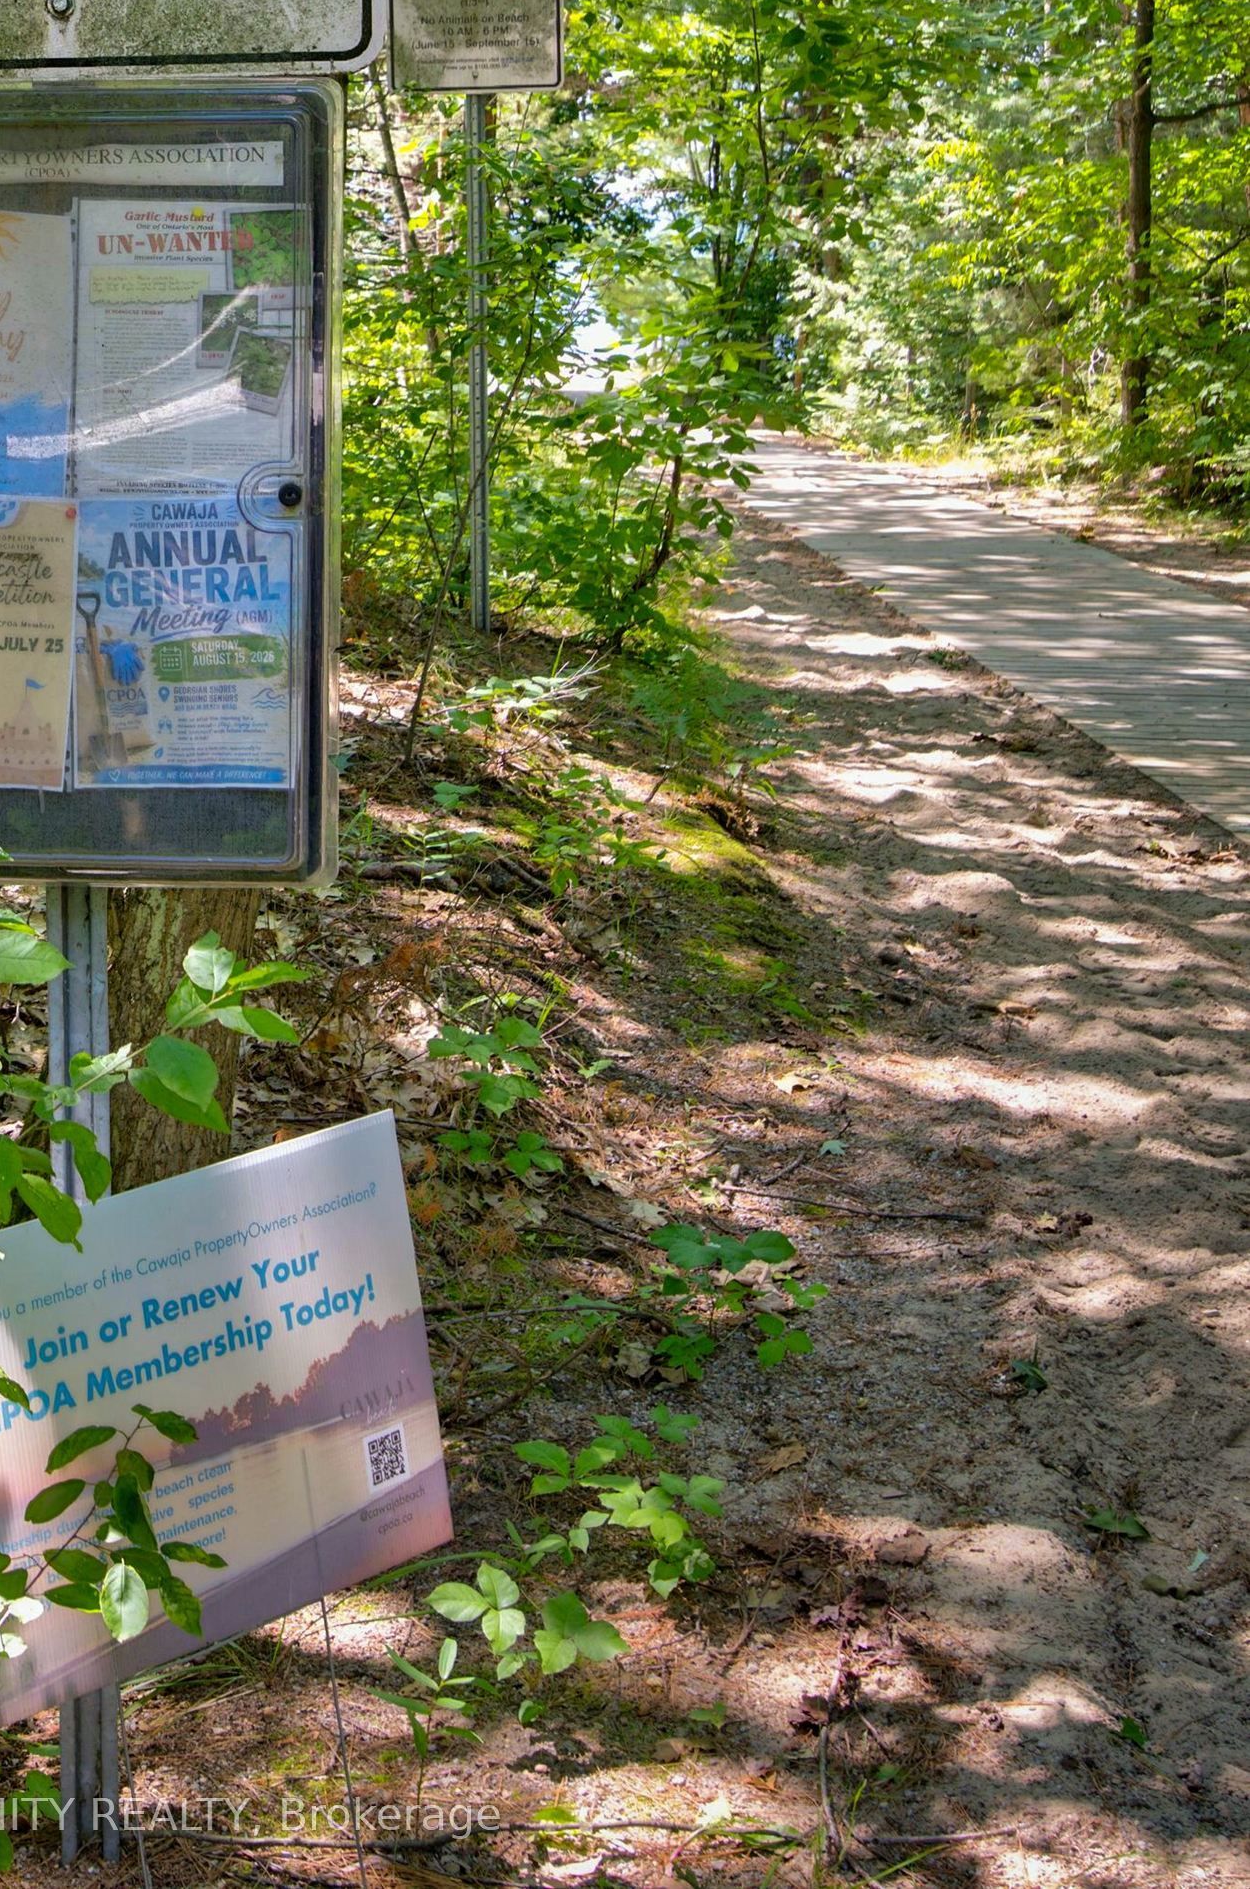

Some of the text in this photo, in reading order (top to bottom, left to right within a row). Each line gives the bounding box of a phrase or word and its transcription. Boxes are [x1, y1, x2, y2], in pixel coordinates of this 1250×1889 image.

[464, 38, 519, 51] September
[128, 146, 266, 163] ASSOCIATION
[24, 167, 70, 178] (CPOA)
[152, 503, 218, 521] CAWAJA
[108, 530, 268, 569] ANNUAL
[105, 564, 280, 608] GENERAL
[130, 606, 273, 637] Meeting (AGM)
[45, 639, 64, 653] 25
[192, 653, 231, 666] AUGUST
[251, 651, 275, 663] 2026
[107, 688, 146, 702] CPOA
[15, 1304, 26, 1315] a
[31, 1281, 88, 1312] member
[93, 1270, 107, 1289] of
[111, 1266, 133, 1285] the
[137, 1247, 191, 1276] Cawaja
[195, 1214, 298, 1257] PropertyOwners
[302, 1182, 377, 1222] Association?
[24, 1250, 320, 1370] Join or Renew Your
[86, 1315, 272, 1403] Membership
[280, 1273, 376, 1332] Today!
[155, 1475, 195, 1499] beach
[188, 1482, 234, 1510] species
[360, 1485, 426, 1522] @cawajabeach
[157, 1505, 237, 1542] maintenance,
[378, 1512, 413, 1536] cpoa.ca
